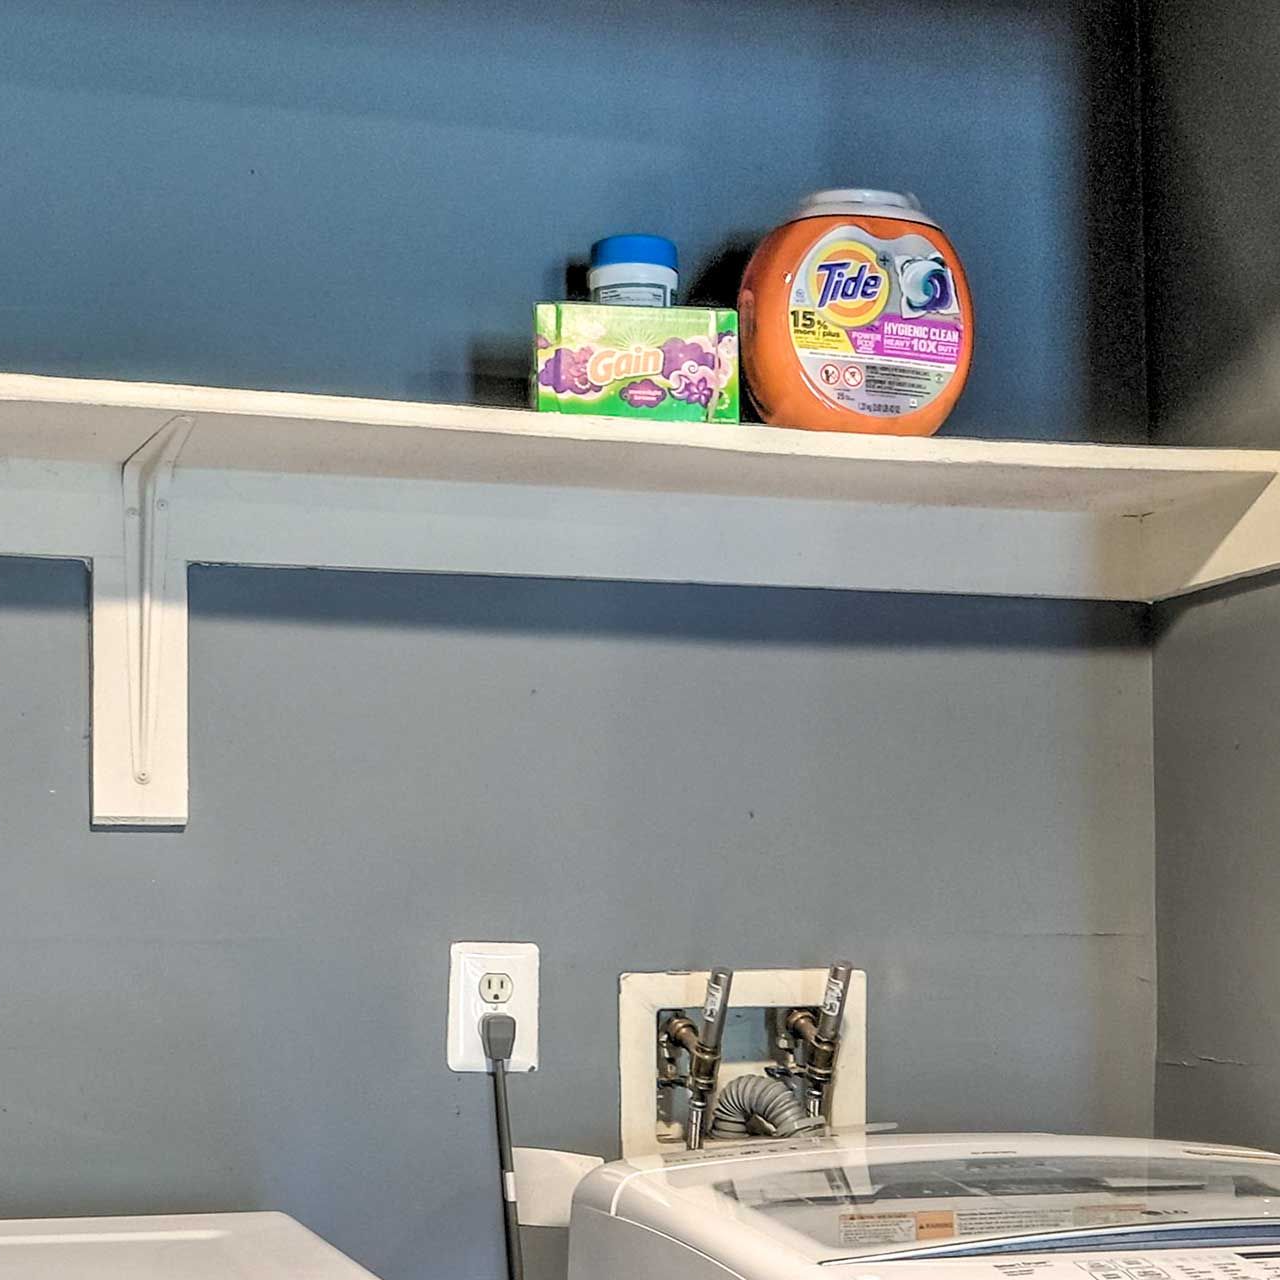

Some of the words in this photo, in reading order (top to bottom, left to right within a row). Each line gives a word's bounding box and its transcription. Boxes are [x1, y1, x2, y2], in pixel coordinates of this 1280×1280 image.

[817, 262, 882, 308] Tide
[884, 321, 929, 339] HYGIENIC
[929, 327, 959, 343] CLEAN
[884, 338, 910, 347] HEAVY
[911, 338, 938, 354] 10X
[591, 347, 660, 384] Gain
